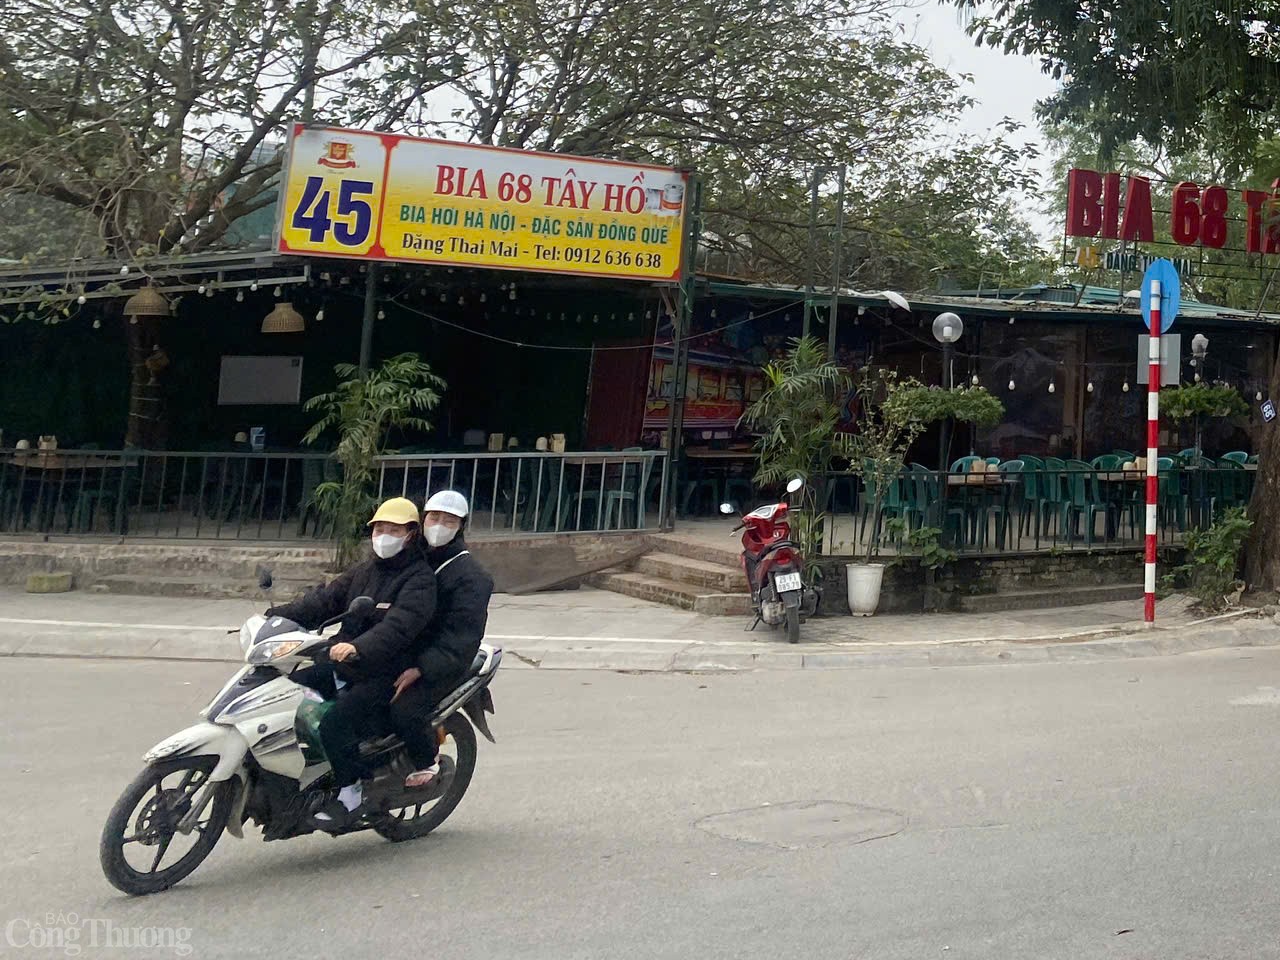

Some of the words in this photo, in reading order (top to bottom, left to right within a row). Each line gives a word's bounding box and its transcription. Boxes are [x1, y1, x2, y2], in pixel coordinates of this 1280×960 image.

[291, 175, 374, 247] 45
[433, 164, 488, 200] BIA
[497, 172, 533, 204] 68
[541, 168, 598, 210] TÂY
[602, 171, 646, 215] HỒ
[1066, 168, 1154, 243] BIA
[1171, 181, 1229, 249] 68
[400, 204, 425, 223] BIA
[464, 208, 484, 228] HÀ
[489, 209, 516, 235] NỘI
[531, 215, 561, 239] ĐẶC
[566, 216, 594, 238] SẢN
[641, 224, 668, 245] QUÊ
[402, 232, 445, 255] Đặng
[449, 236, 484, 255] Thai
[489, 239, 518, 258] Mai
[534, 244, 560, 261] Tel:
[564, 246, 600, 265] 0912
[605, 250, 631, 267] 636
[635, 252, 661, 268] 638
[1073, 246, 1101, 269] 45
